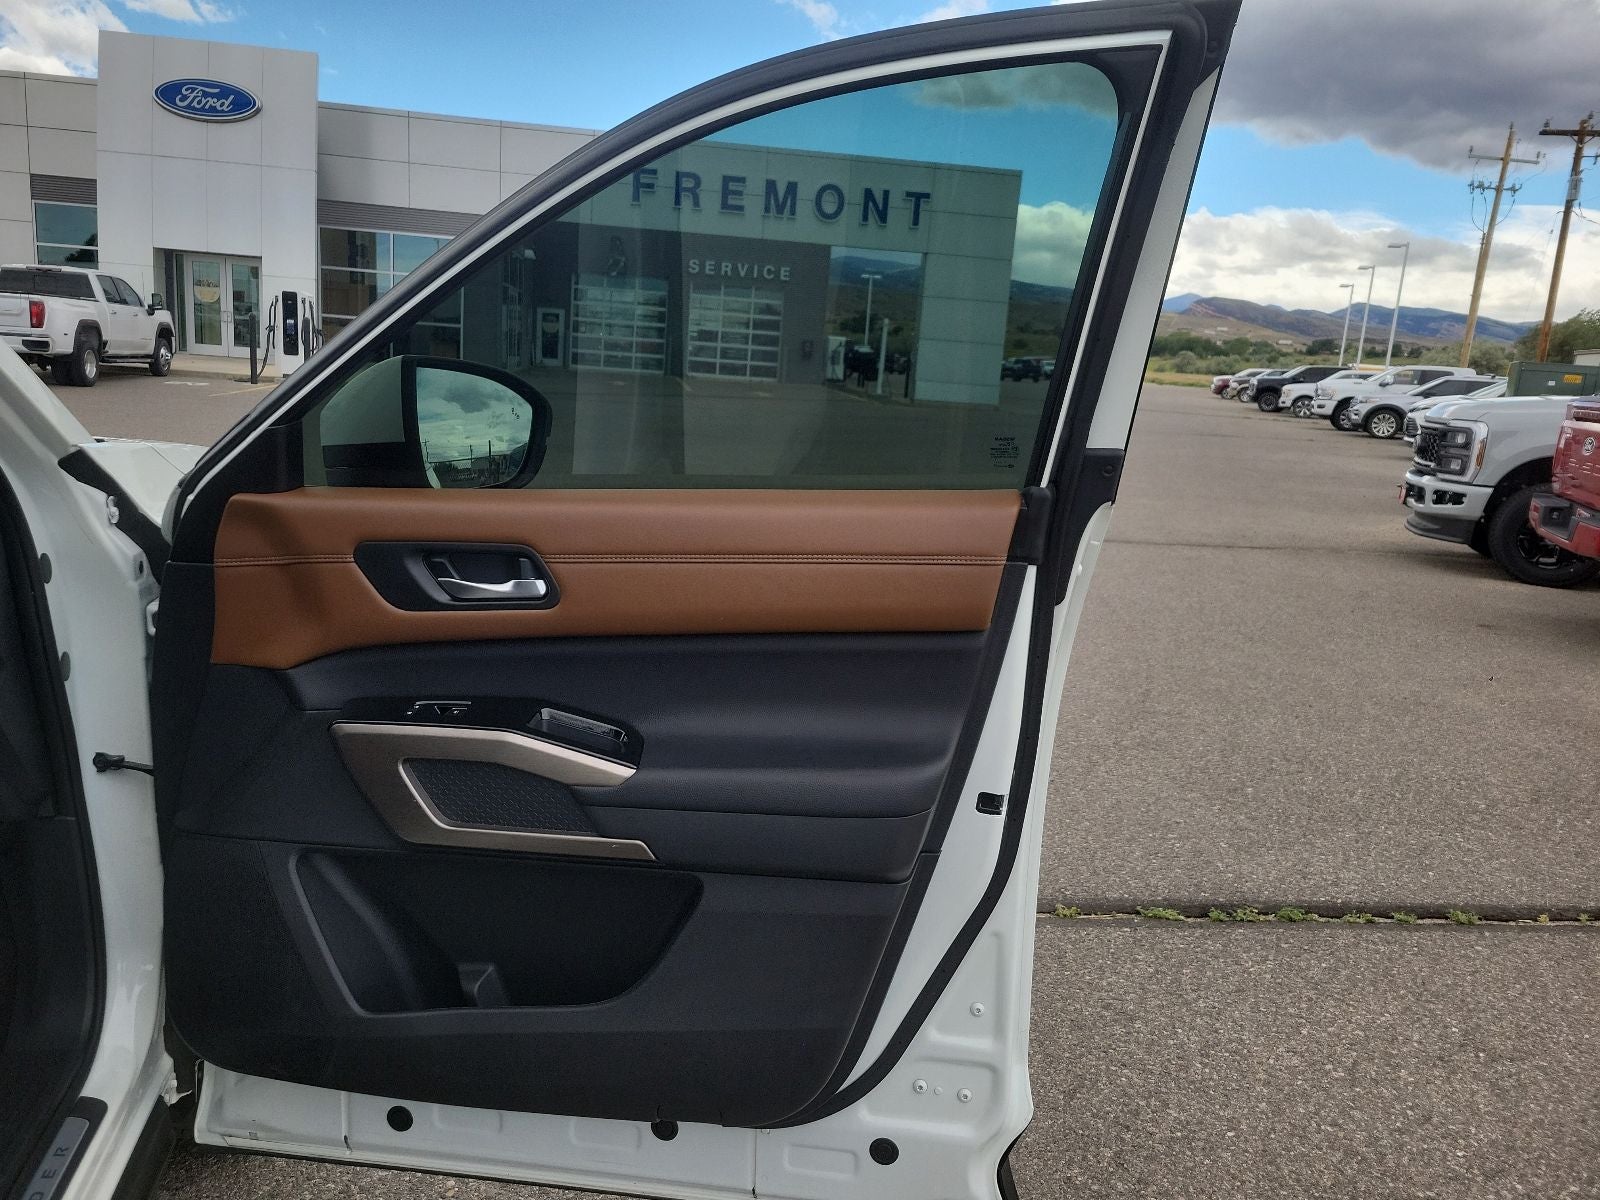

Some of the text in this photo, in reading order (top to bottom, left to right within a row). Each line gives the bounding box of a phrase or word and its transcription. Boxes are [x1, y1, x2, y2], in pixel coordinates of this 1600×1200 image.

[175, 84, 235, 112] Ford
[630, 168, 931, 228] FREMONT
[688, 258, 792, 281] SERVICE
